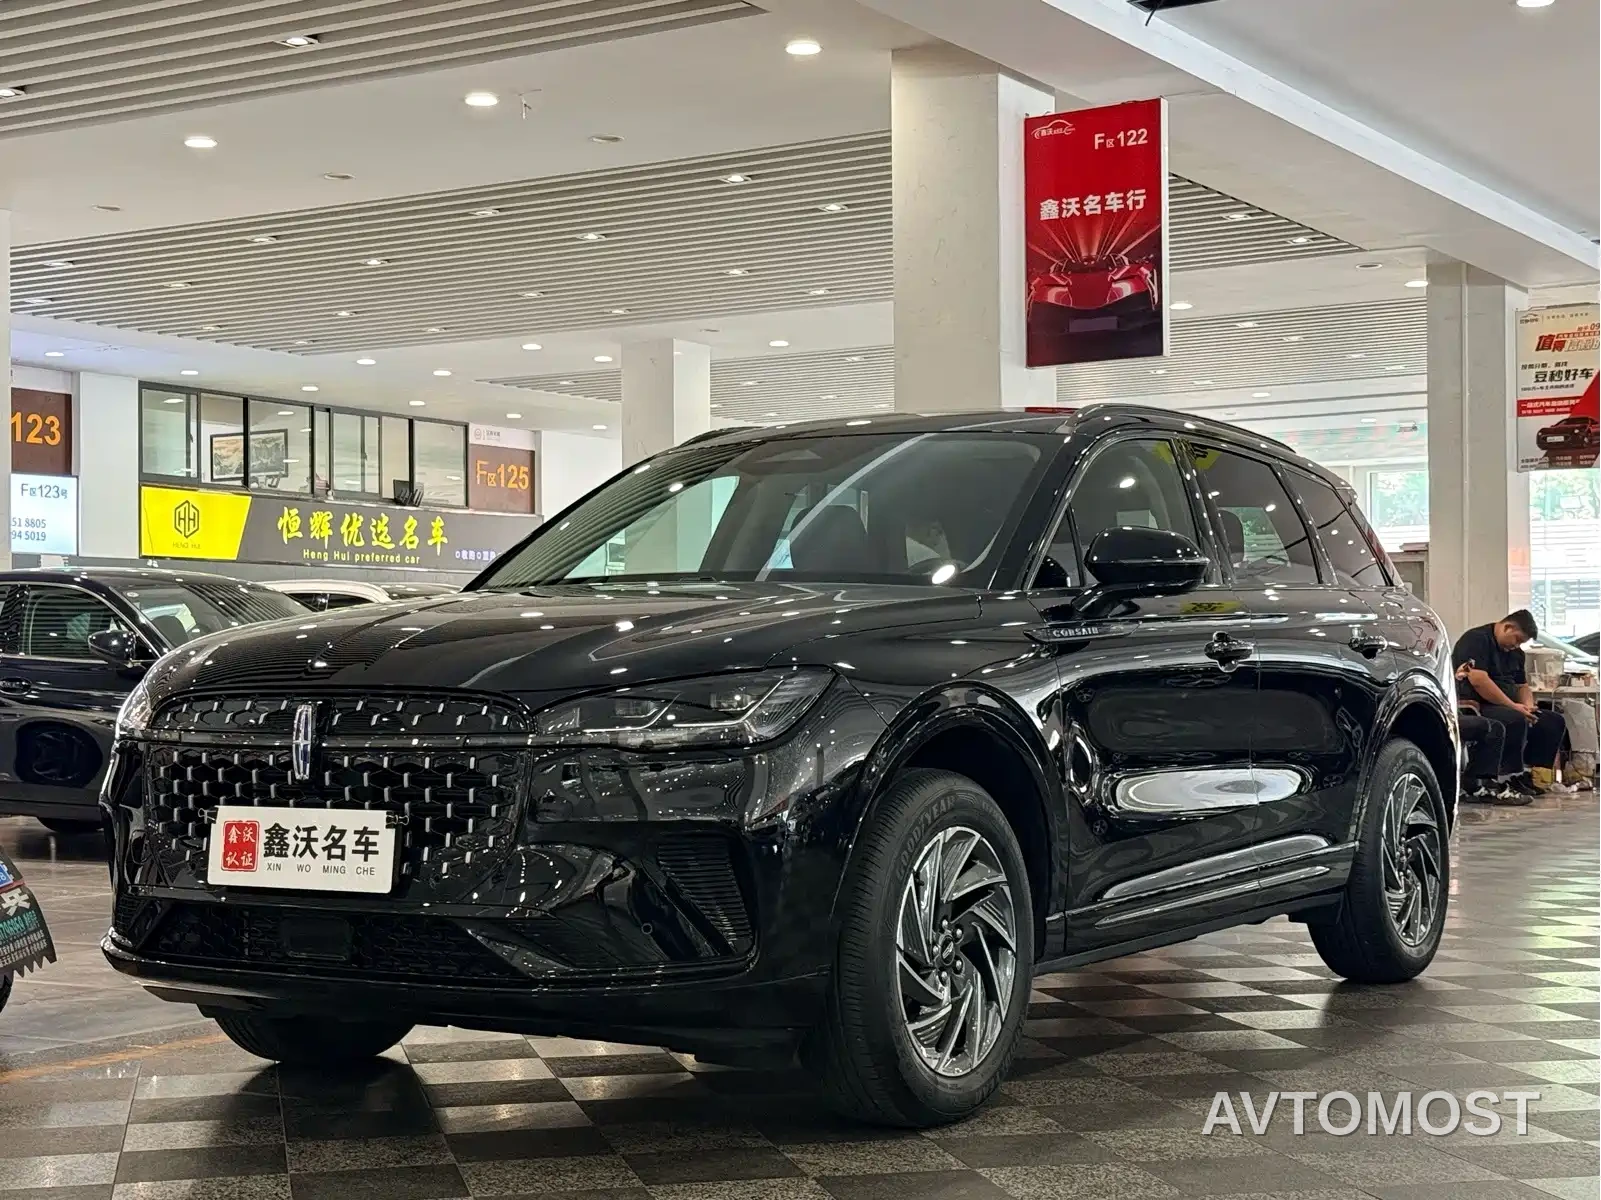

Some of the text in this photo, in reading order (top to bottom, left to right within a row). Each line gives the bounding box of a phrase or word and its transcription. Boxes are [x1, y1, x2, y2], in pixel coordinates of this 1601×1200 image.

[1094, 128, 1148, 150] F区122
[1039, 189, 1147, 221] 鑫沃名车行
[1533, 368, 1594, 383] 豆秒好车
[10, 411, 61, 446] 123
[476, 459, 529, 490] F区125
[20, 483, 68, 499] F区123号
[24, 517, 47, 529] 8805
[277, 506, 449, 556] 恒辉优选名车
[24, 530, 47, 541] 5019
[303, 549, 420, 564] Heng Hui preferred car
[1052, 627, 1099, 638] CORSAIR
[227, 825, 256, 844] 鑫沃
[263, 822, 380, 862] 鑫沃名车
[225, 851, 254, 867] 认证
[266, 862, 376, 876] XIN WO MING CHE
